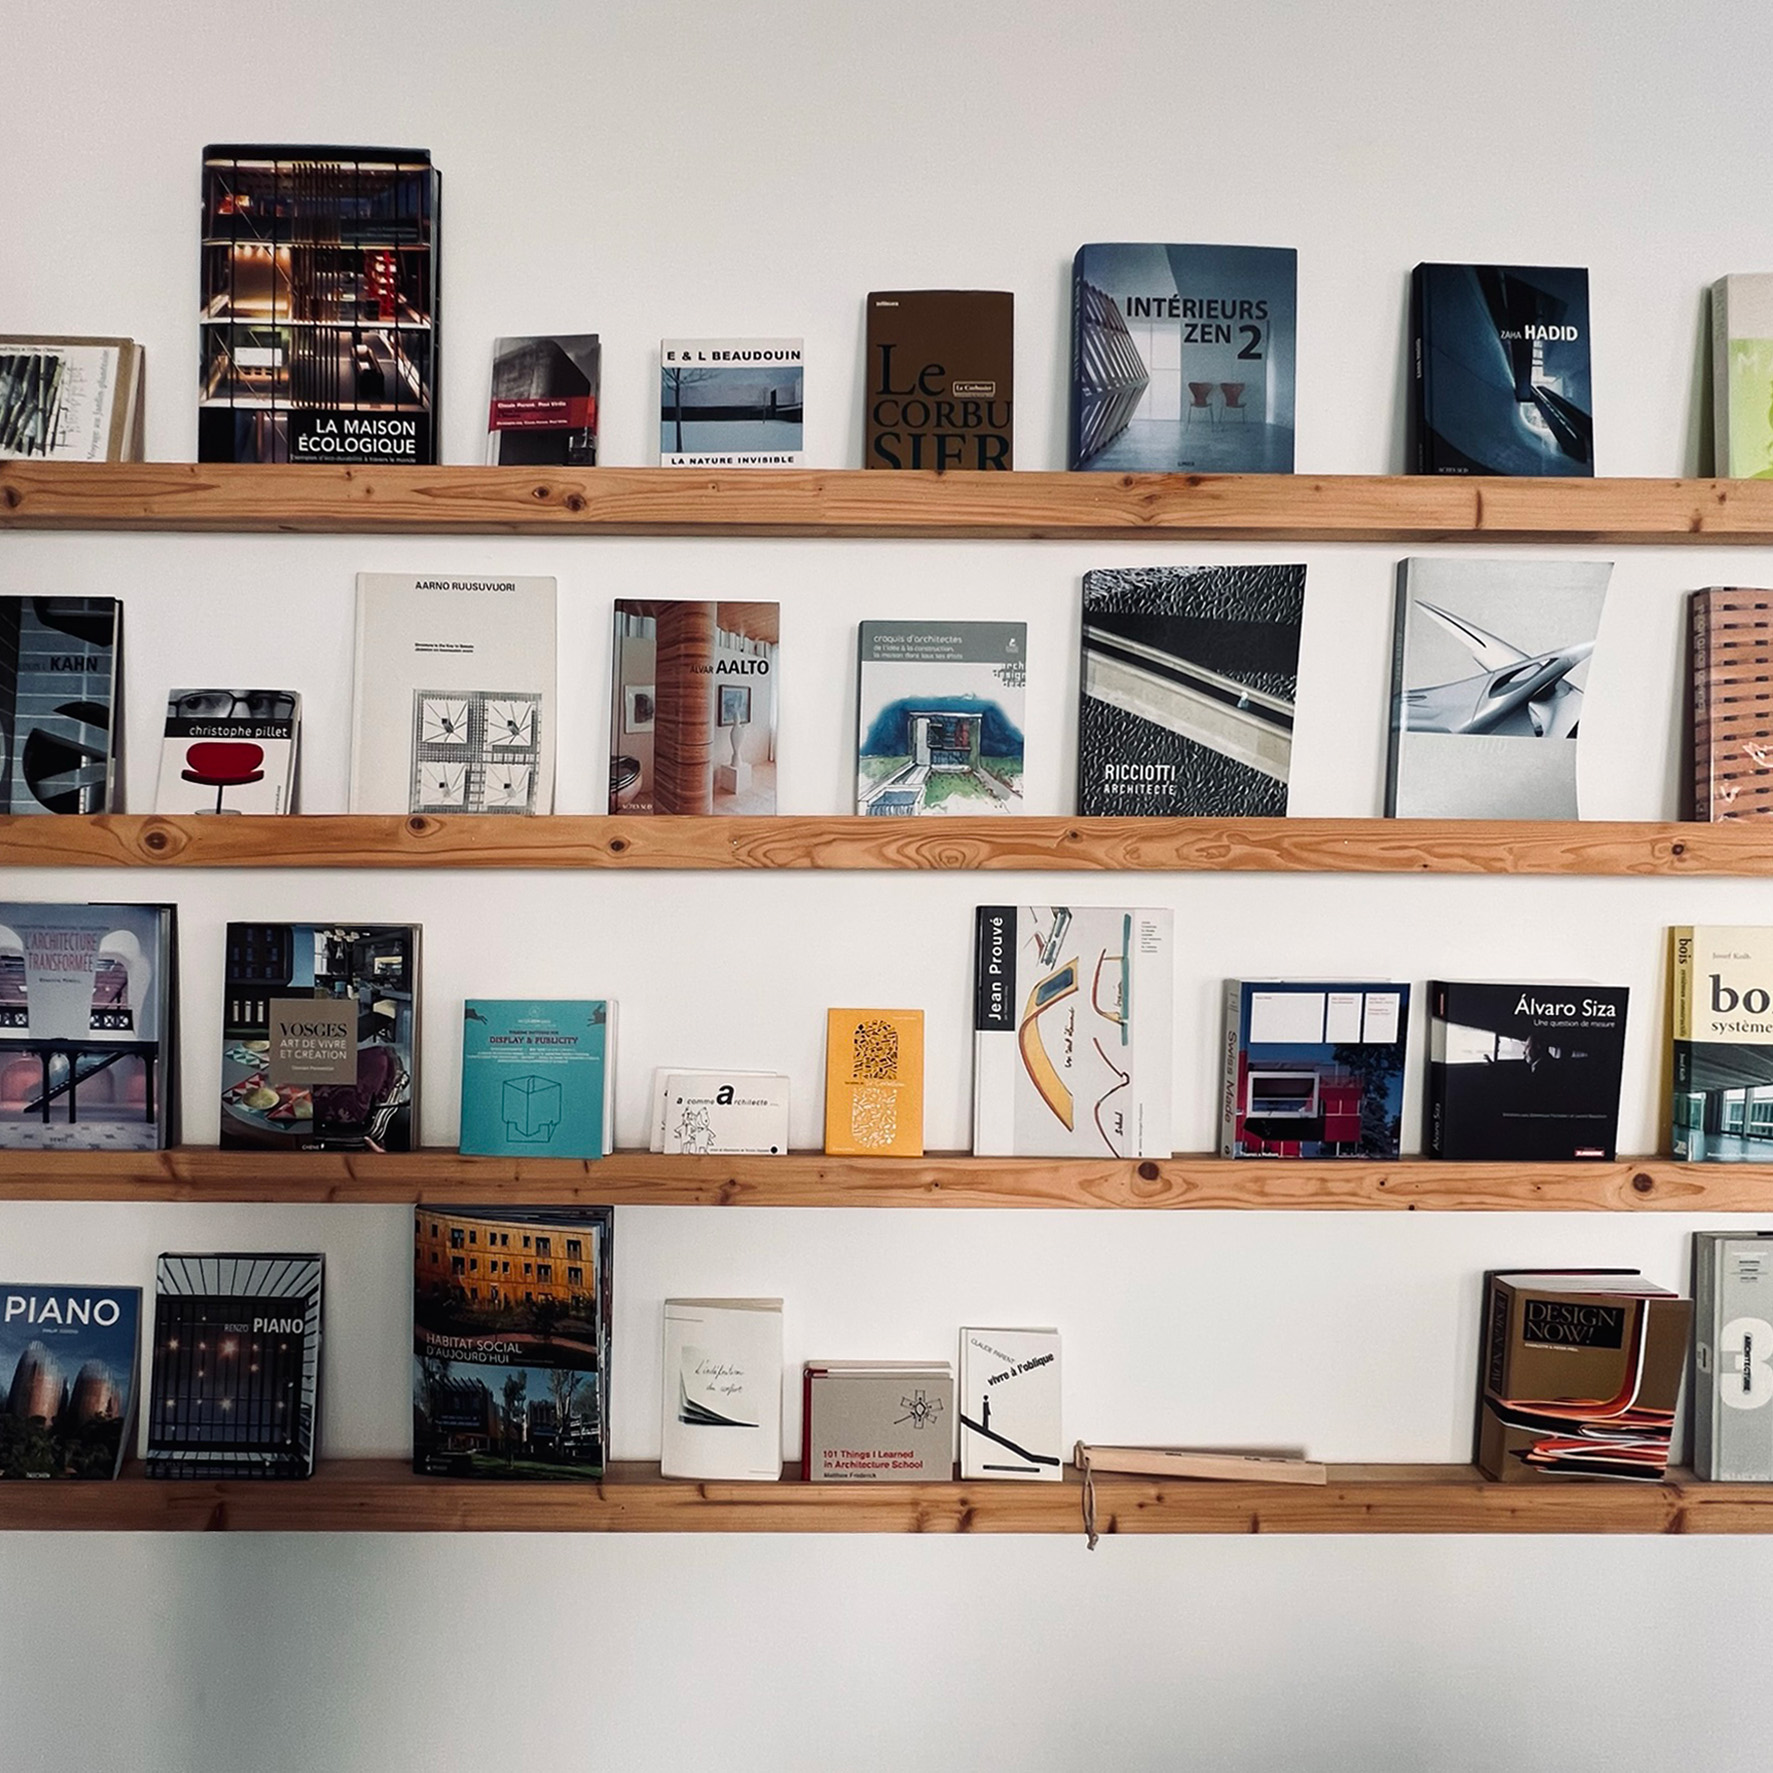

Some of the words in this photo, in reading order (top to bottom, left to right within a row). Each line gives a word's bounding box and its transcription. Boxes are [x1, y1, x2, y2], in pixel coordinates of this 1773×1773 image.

[1126, 294, 1269, 320] INTÉRIEURS
[1183, 323, 1232, 344] ZEN
[1237, 324, 1263, 360] 2
[1500, 330, 1522, 340] ZAHA
[1524, 324, 1579, 341] HADID
[667, 351, 676, 361] E
[681, 351, 692, 361] &
[698, 351, 706, 361] L
[712, 350, 801, 361] BEAUDOUIN
[875, 343, 946, 397] Le
[872, 399, 1014, 429] CORBU
[316, 419, 338, 434] LA
[344, 420, 416, 436] MAISON
[298, 433, 416, 454] ÉCOLOGIQUE
[689, 457, 733, 465] NATURE
[737, 456, 794, 464] INVISIBLE
[415, 581, 451, 591] AARNO
[451, 582, 516, 592] RUUSUVUORI
[873, 635, 905, 646] croquis
[906, 634, 963, 644] d'architectes
[50, 656, 98, 673] KAHN
[715, 659, 770, 675] AALTO
[189, 725, 252, 738] christophe
[255, 725, 288, 738] pillet
[1105, 763, 1176, 781] RICCIOTTI
[1103, 783, 1176, 796] ARCHITECTE
[25, 930, 98, 951] L'ARCHITECTURE
[989, 916, 1004, 974] Prouvé
[1678, 938, 1692, 965] bois
[28, 952, 94, 973] TRANSFORMÉE
[988, 981, 1002, 1021] Jean
[1709, 974, 1773, 1014] bo
[1513, 993, 1576, 1017] Álvaro
[1581, 998, 1617, 1018] Siza
[279, 1022, 348, 1038] VOSGES
[1533, 1018, 1549, 1027] Une
[1550, 1018, 1580, 1029] question
[1580, 1019, 1590, 1028] de
[279, 1039, 299, 1048] ART
[302, 1039, 315, 1048] DE
[318, 1039, 347, 1049] VIVRE
[489, 1036, 525, 1045] DISPLAY
[526, 1036, 533, 1045] &
[534, 1036, 579, 1045] PUBLICITY
[280, 1050, 292, 1060] ET
[294, 1049, 348, 1060] CRÉATION
[1226, 1031, 1238, 1076] Swiss
[1224, 1080, 1236, 1123] Made
[4, 1295, 121, 1327] PIANO
[1528, 1302, 1618, 1327] DESIGN
[224, 1323, 250, 1333] RENZO
[252, 1317, 305, 1335] PIANO
[1526, 1321, 1595, 1345] NOW!
[426, 1333, 473, 1349] HABITAT
[476, 1340, 523, 1354] SOCIAL
[970, 1338, 993, 1354] CLAUDE
[993, 1349, 1016, 1365] PARENT
[426, 1345, 511, 1364] D'AUJOURD'HUI
[987, 1371, 1010, 1387] vivre
[1010, 1366, 1018, 1378] à
[1016, 1353, 1055, 1375] l'oblique
[823, 1451, 838, 1459] 101
[841, 1451, 871, 1461] Things
[873, 1451, 877, 1459] I
[878, 1451, 915, 1459] Learned
[824, 1461, 833, 1469] in
[834, 1461, 891, 1469] Architecture
[891, 1461, 924, 1469] School
